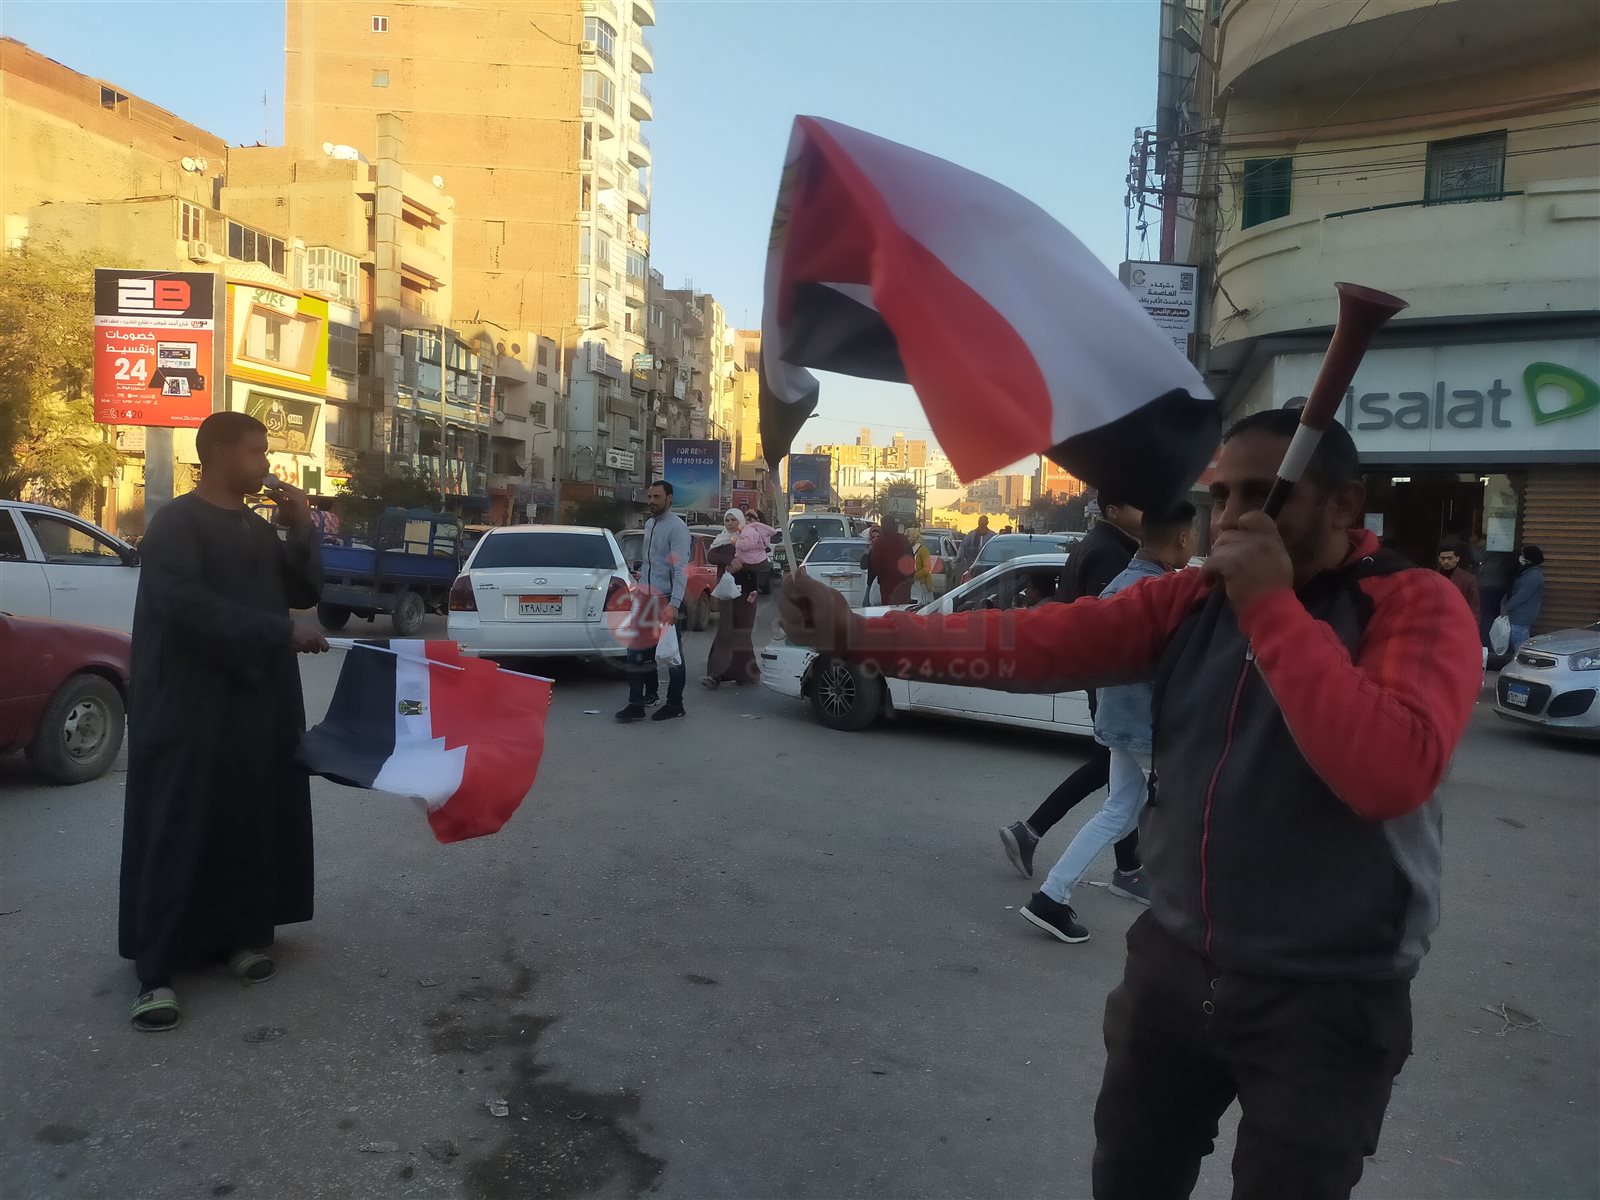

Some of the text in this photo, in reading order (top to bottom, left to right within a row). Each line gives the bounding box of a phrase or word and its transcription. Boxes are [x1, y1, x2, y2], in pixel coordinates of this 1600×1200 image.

[105, 330, 156, 341] خصومات
[114, 358, 147, 381] 24
[1282, 379, 1512, 432] isalat
[116, 409, 143, 419] 16420
[676, 447, 708, 455] FOR RENT
[520, 604, 540, 613] ١٣٩٨
